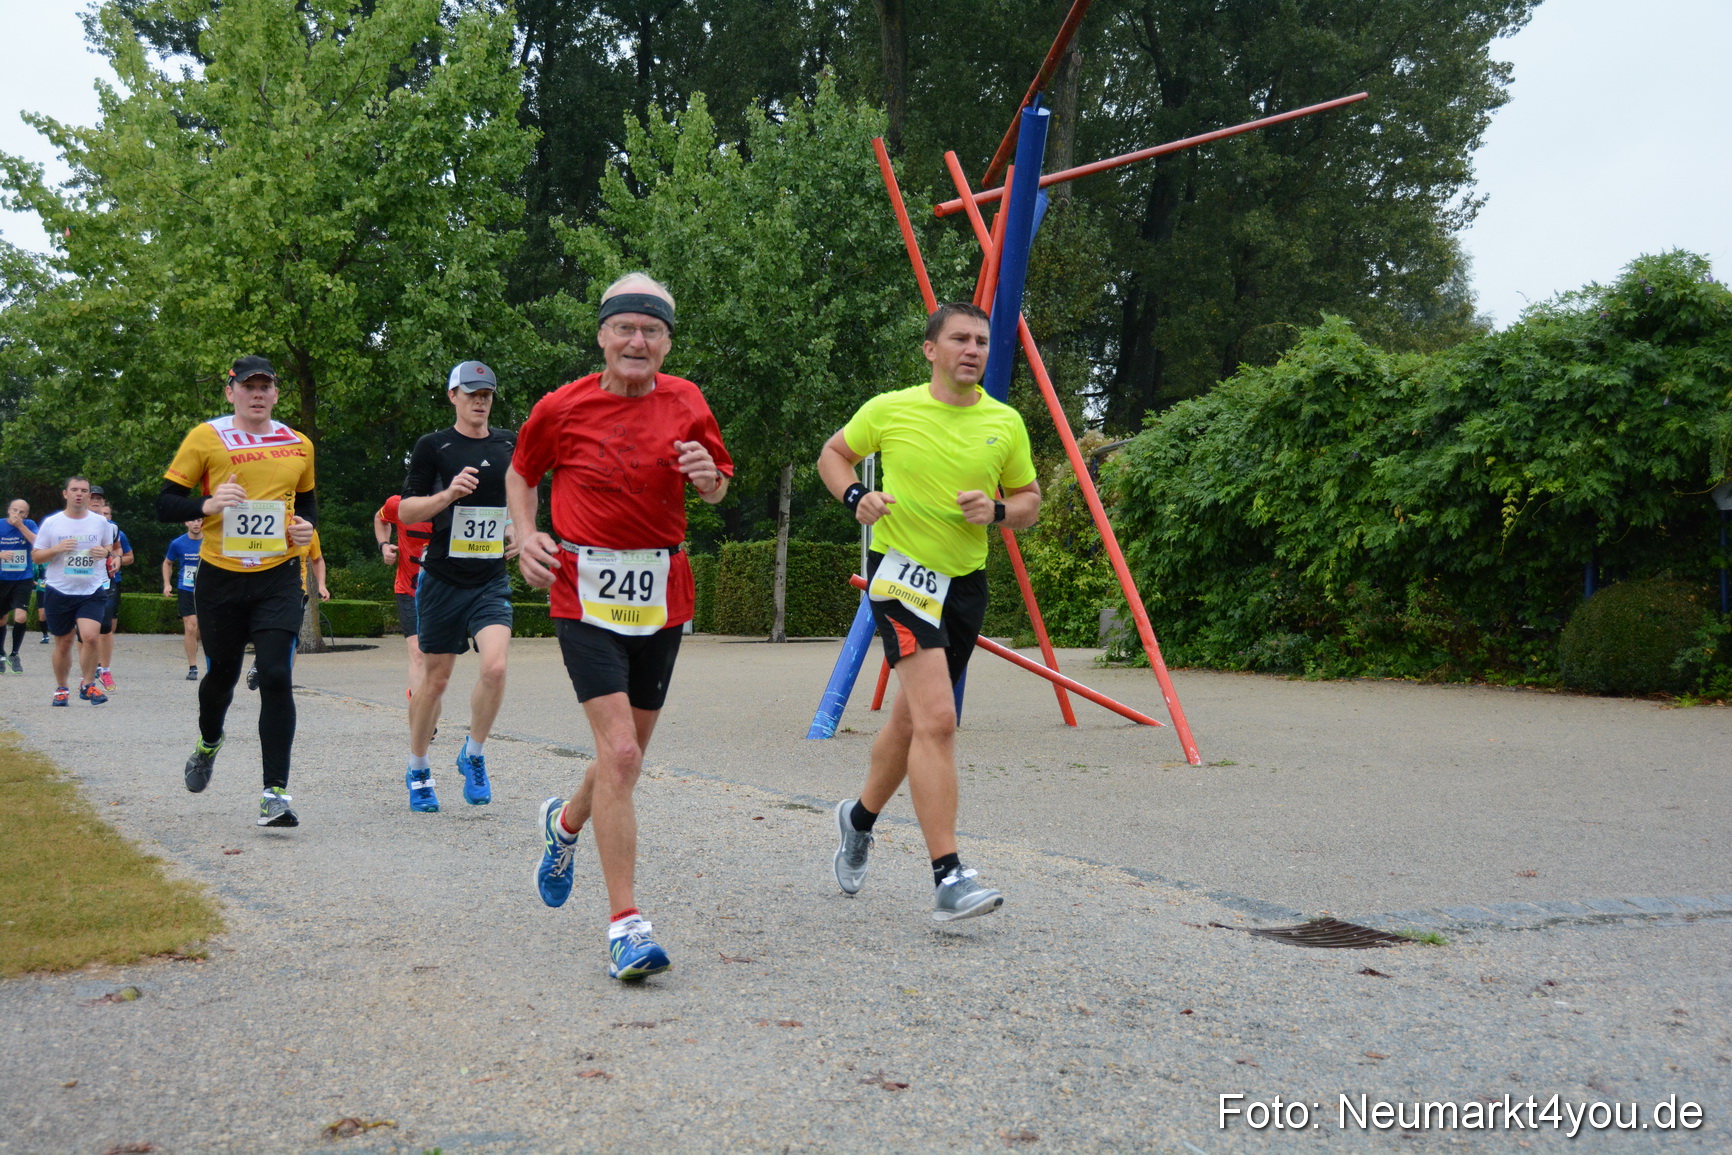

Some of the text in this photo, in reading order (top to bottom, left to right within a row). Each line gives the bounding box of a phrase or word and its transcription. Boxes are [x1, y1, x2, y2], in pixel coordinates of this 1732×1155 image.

[230, 447, 307, 466] MAX BÖGL
[236, 514, 276, 536] 322
[463, 519, 497, 539] 312
[248, 540, 263, 550] Jiri
[467, 543, 491, 552] Marco
[67, 556, 94, 567] 2865
[598, 568, 655, 602] 249
[897, 562, 938, 595] 166
[887, 584, 930, 611] Dominik
[611, 608, 640, 623] Willi
